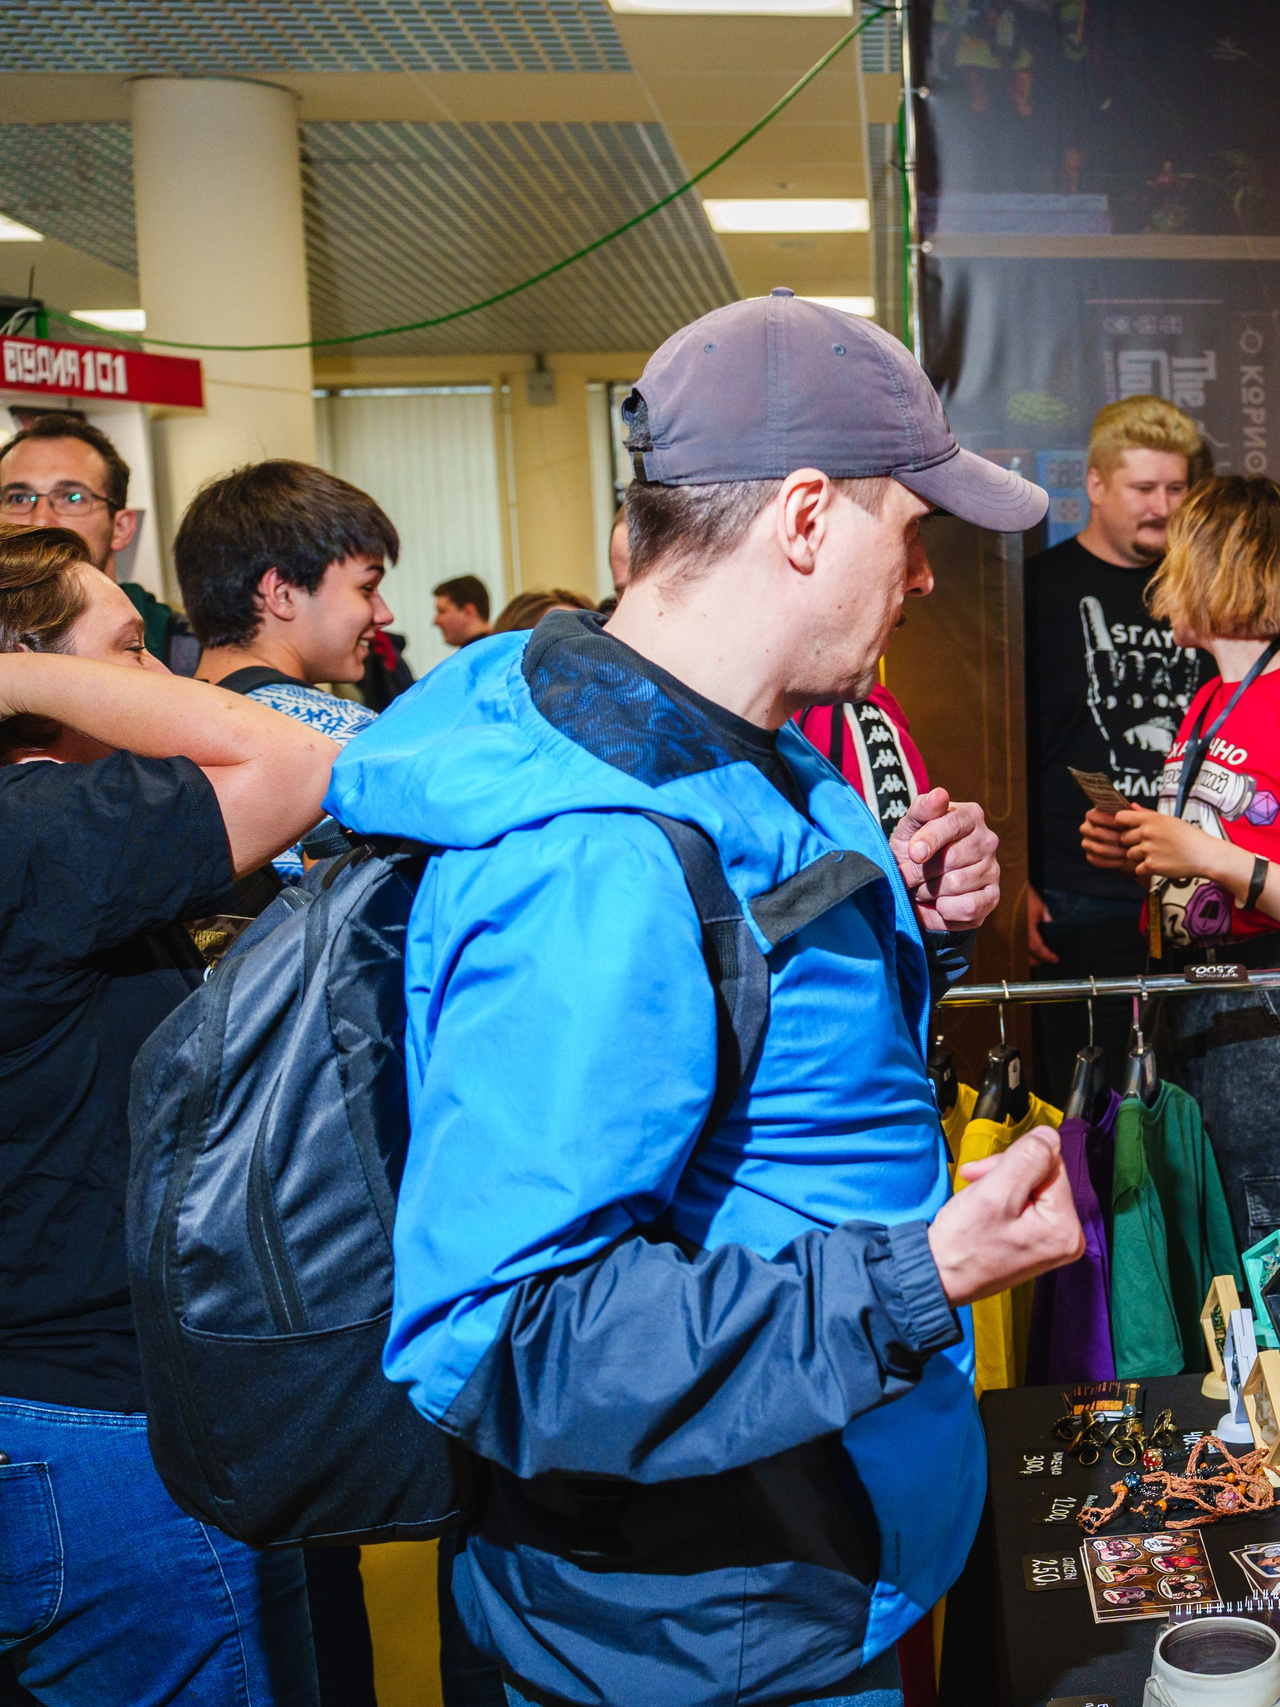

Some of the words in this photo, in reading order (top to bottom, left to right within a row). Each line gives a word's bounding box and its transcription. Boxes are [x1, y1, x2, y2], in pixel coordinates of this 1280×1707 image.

[82, 350, 128, 395] 101
[1171, 350, 1217, 408] The
[1240, 364, 1267, 474] КОРИО
